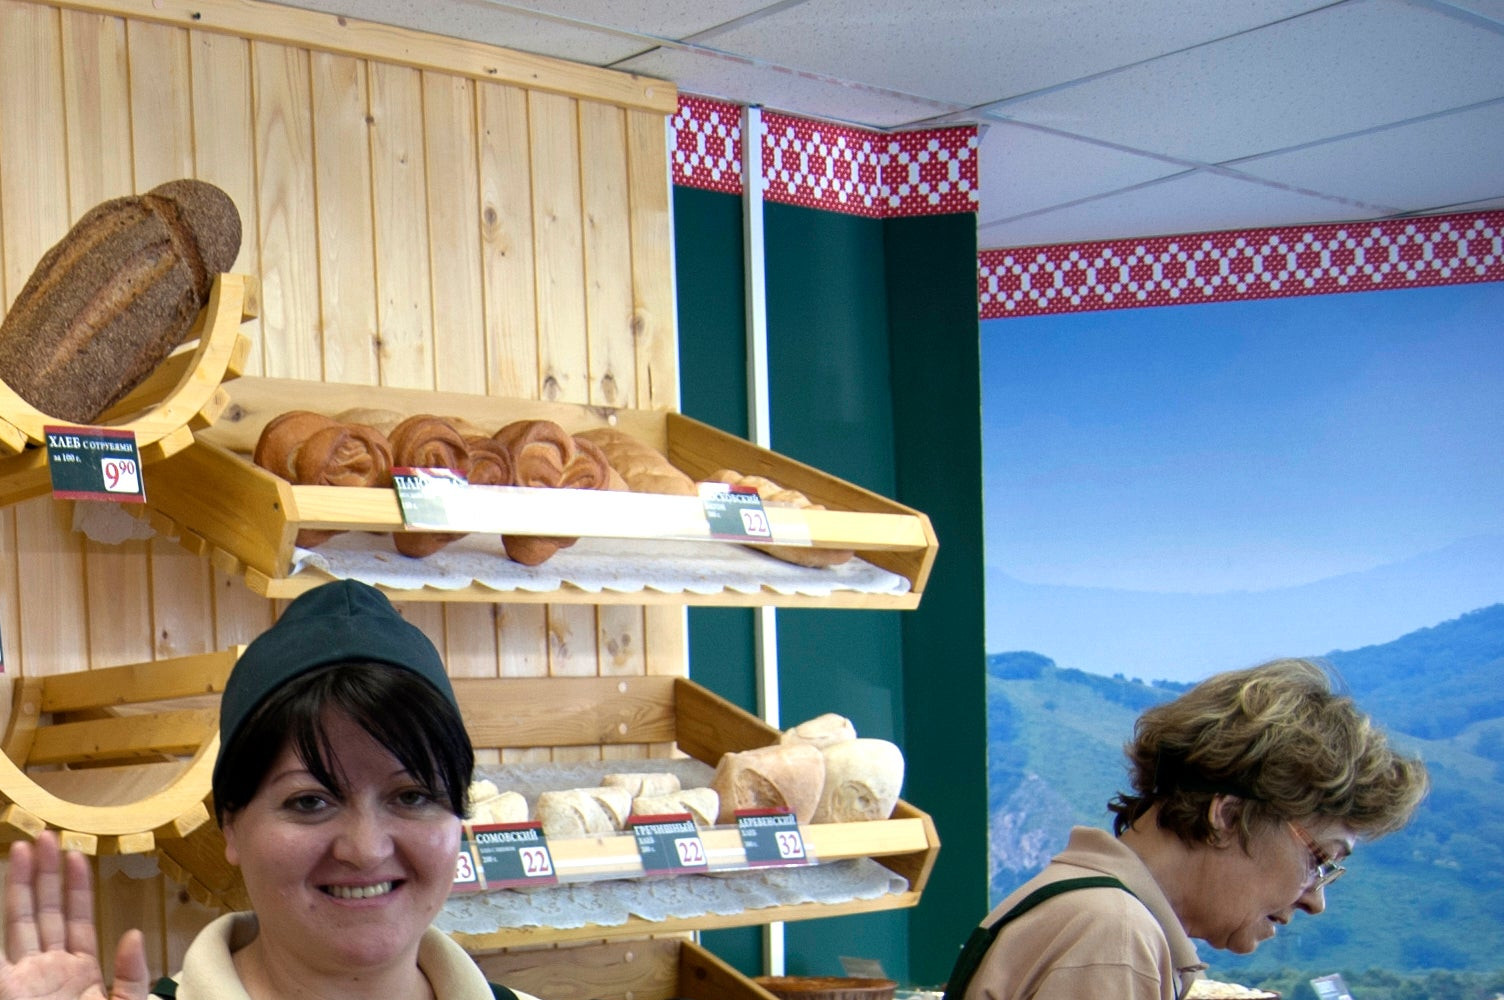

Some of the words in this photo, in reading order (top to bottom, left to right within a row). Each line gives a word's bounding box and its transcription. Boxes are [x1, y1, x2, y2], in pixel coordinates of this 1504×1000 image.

[49, 435, 82, 449] ХЛЕБ
[744, 512, 767, 533] 22
[475, 828, 539, 845] СОМОВСКИЙ
[779, 834, 801, 856] 32
[523, 850, 550, 873] 22
[679, 842, 703, 862] 22
